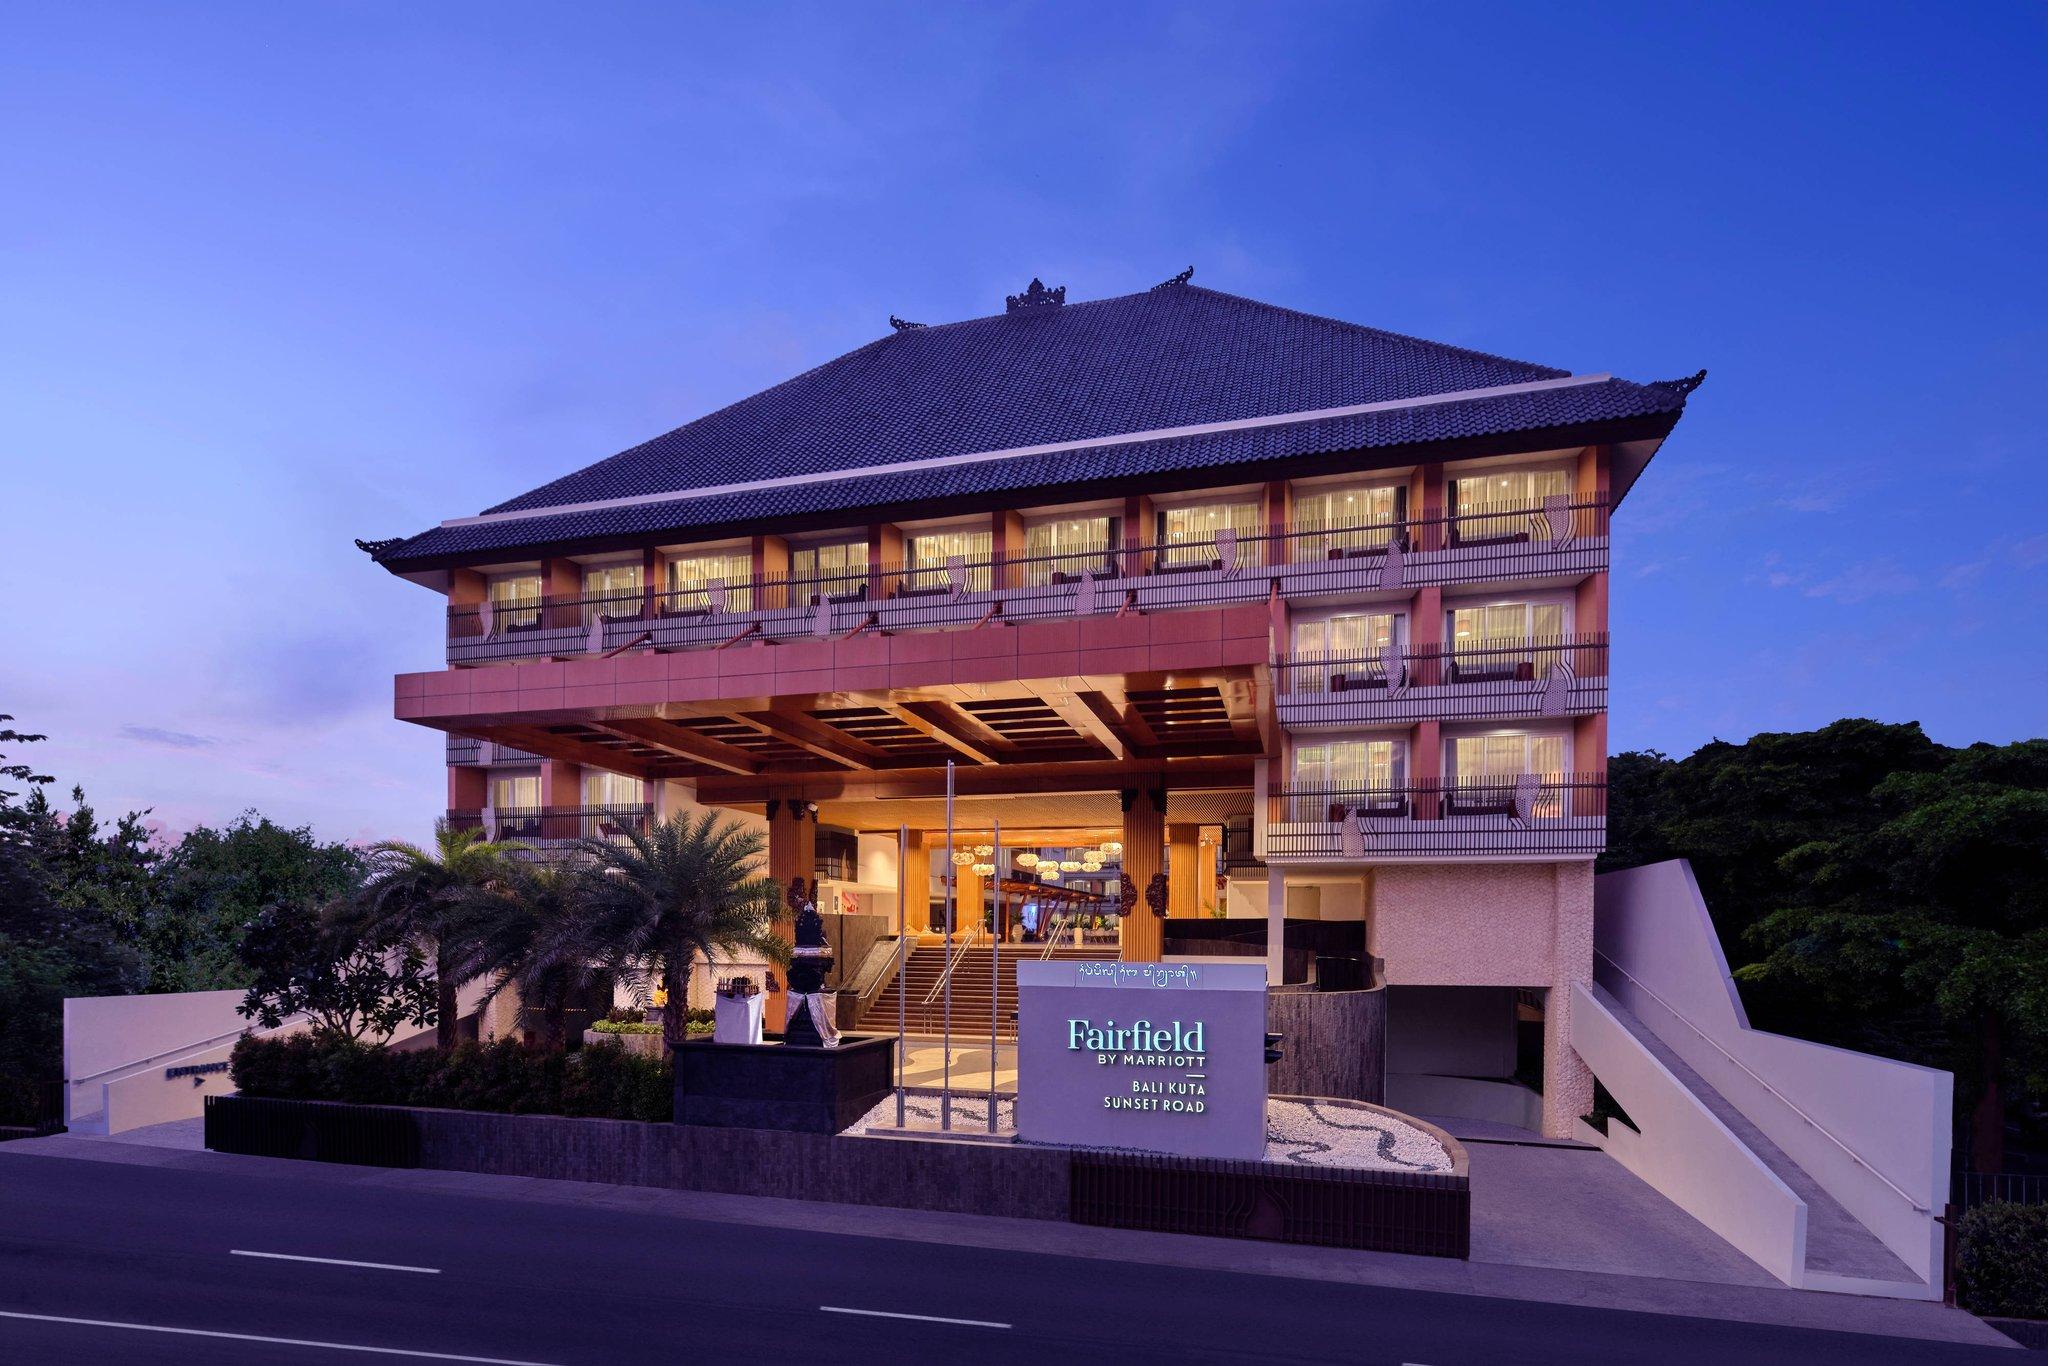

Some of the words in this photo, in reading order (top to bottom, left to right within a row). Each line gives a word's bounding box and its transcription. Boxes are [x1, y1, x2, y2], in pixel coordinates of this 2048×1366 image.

[1067, 1019, 1206, 1053] Fairfield
[1098, 1054, 1117, 1065] BY
[1123, 1054, 1206, 1067] MARRIOTT
[1132, 1080, 1163, 1093] BALI
[1168, 1082, 1206, 1096] KUTA
[1104, 1096, 1159, 1111] SUNSET
[1163, 1099, 1205, 1113] ROAD
